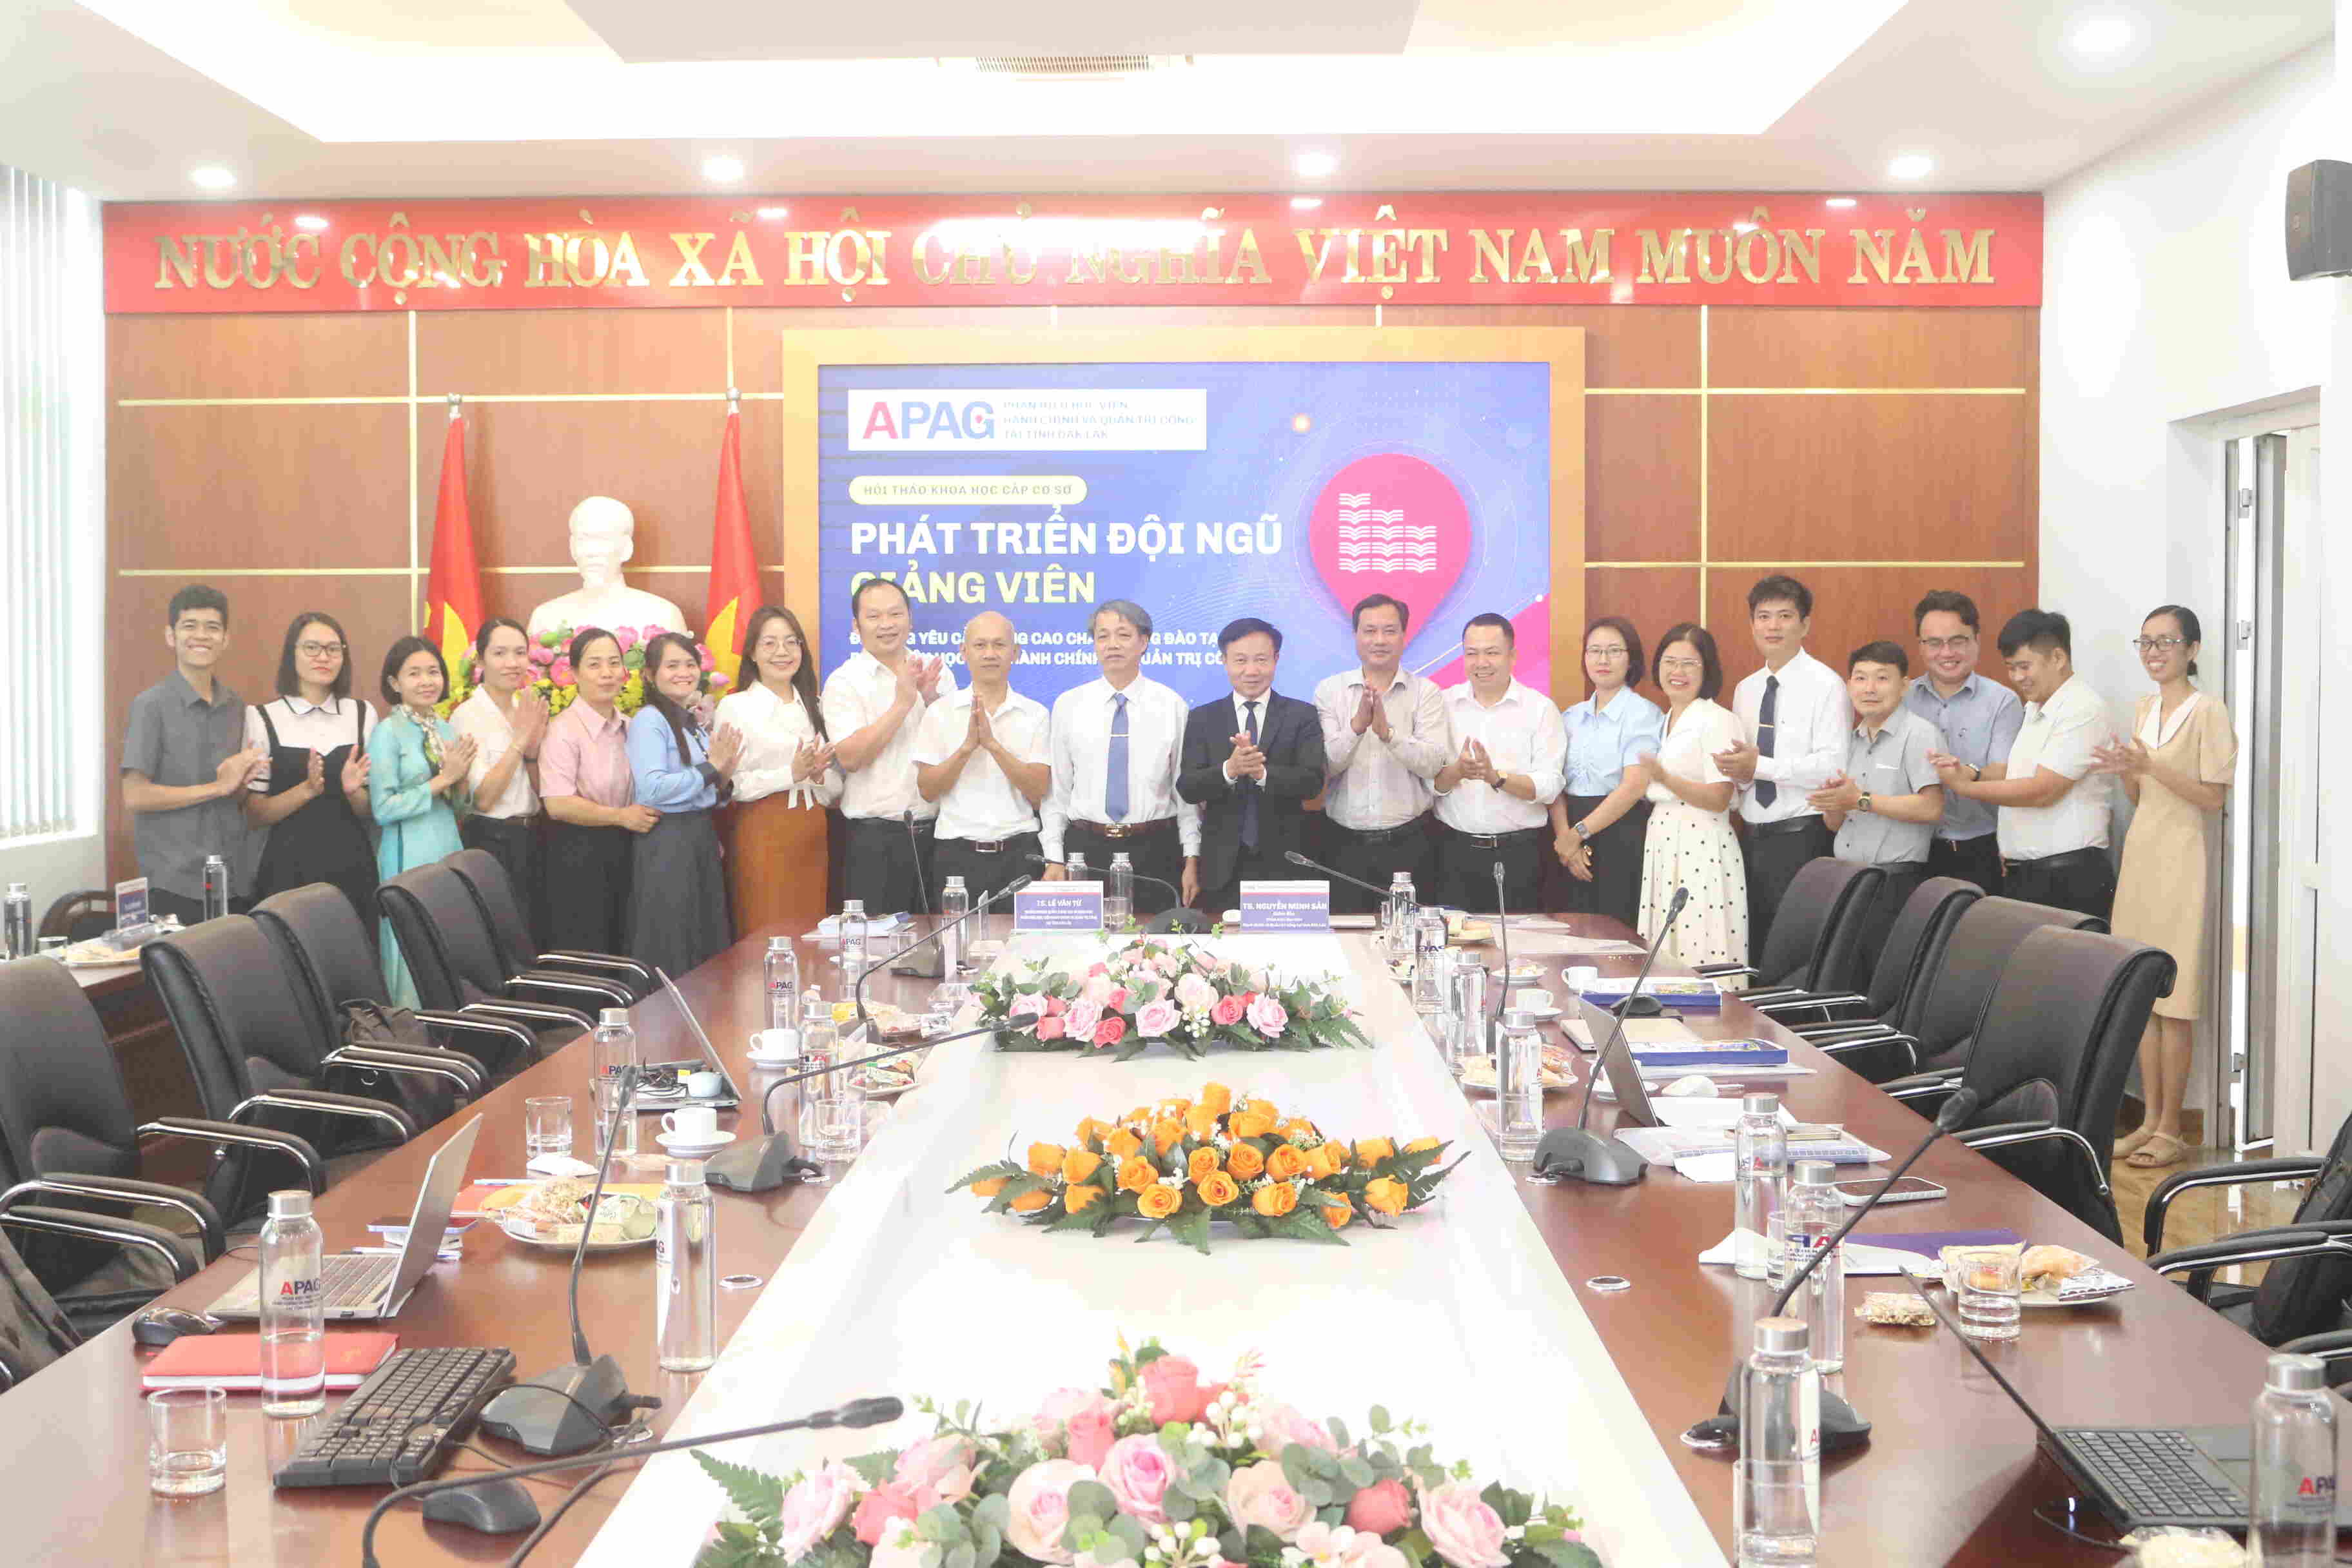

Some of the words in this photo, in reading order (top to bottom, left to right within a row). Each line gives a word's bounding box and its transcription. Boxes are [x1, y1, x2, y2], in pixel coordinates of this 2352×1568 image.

[154, 212, 320, 289] NƯỚC
[340, 212, 509, 305] CỘNG
[523, 209, 650, 288] HÒA
[669, 210, 765, 286] XÃ
[784, 207, 891, 302] HỘI
[1295, 205, 1448, 300] VIỆT
[1469, 228, 1615, 284] NAM
[1636, 206, 1825, 284] MUÔN
[1847, 206, 1995, 285] NĂM
[863, 399, 995, 439] APAG
[852, 515, 961, 554] PHÁT
[970, 502, 1097, 554] TRIỂN
[1107, 514, 1186, 562] ĐỘI
[1197, 513, 1283, 554] NGŨ
[996, 564, 1095, 603] VIÊN
[917, 629, 948, 645] YÊU
[1031, 632, 1063, 645] CAO
[1163, 629, 1197, 645] ĐÀO
[1199, 632, 1218, 647] TẠ
[1176, 652, 1202, 668] TRỊ
